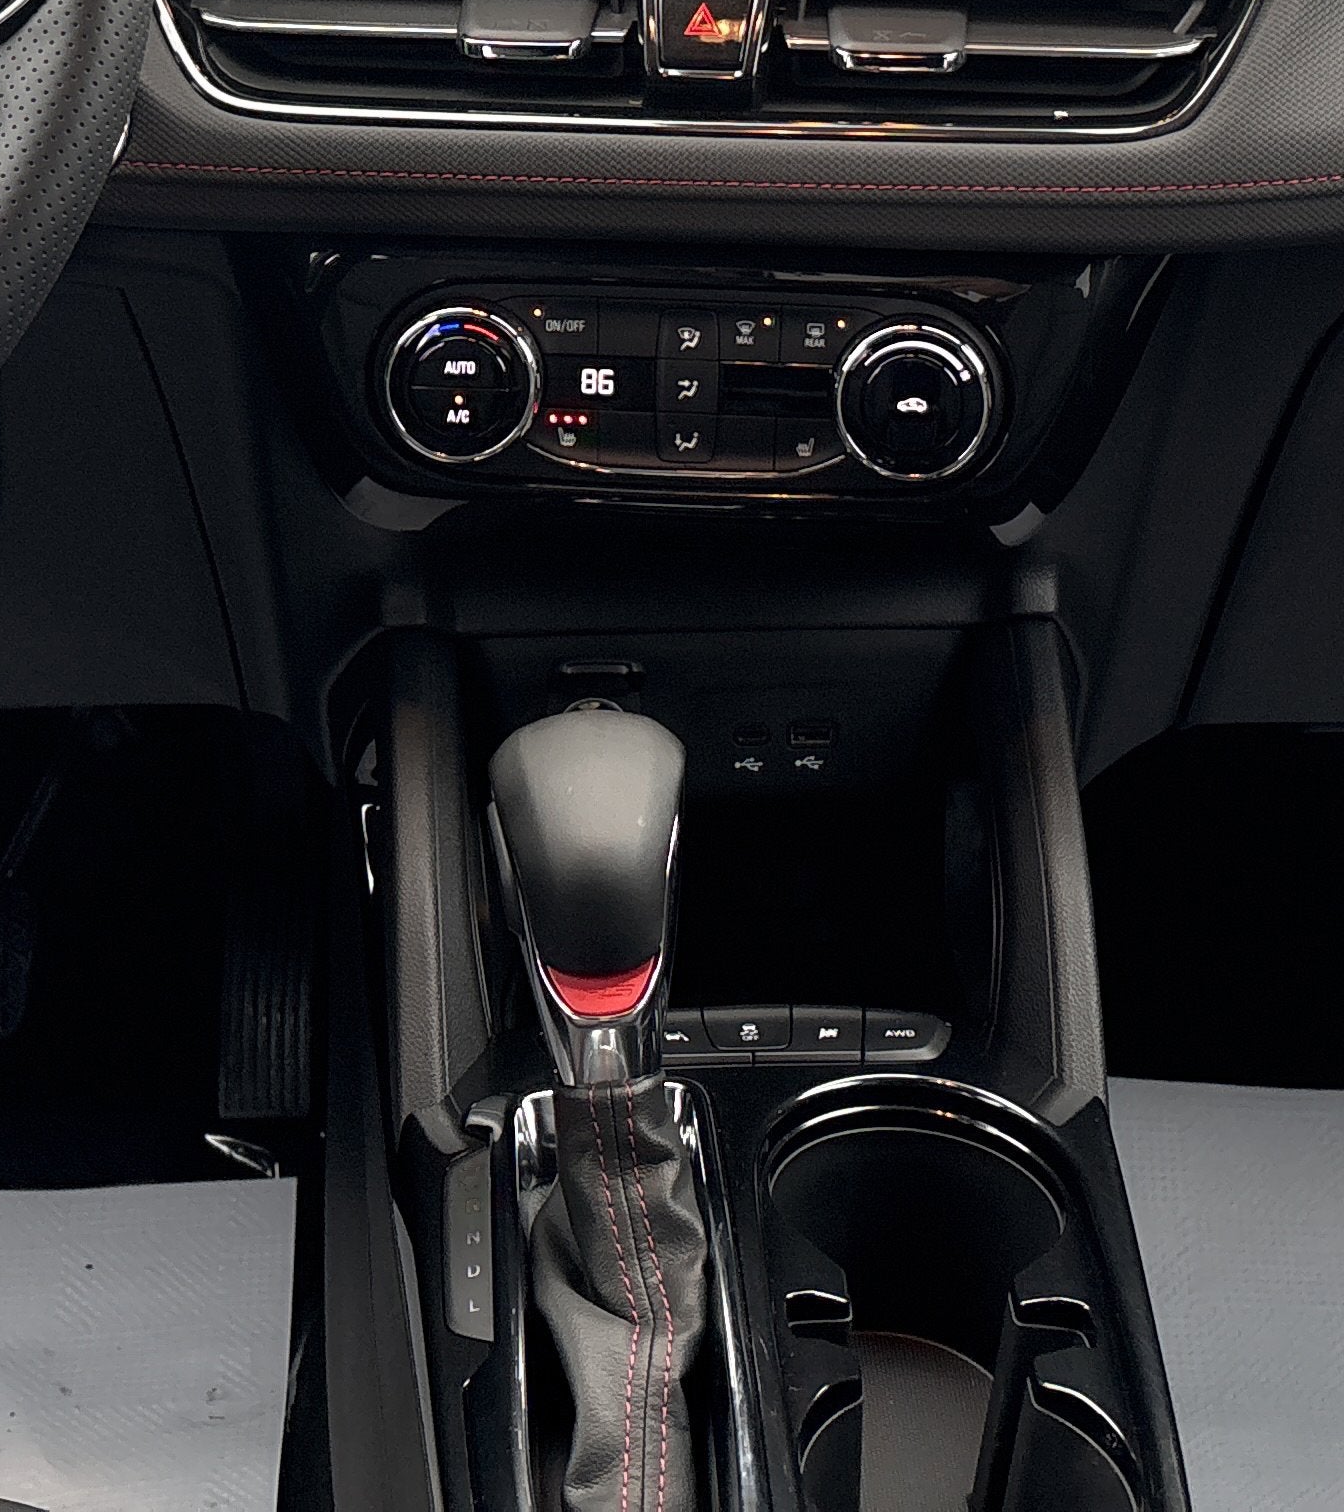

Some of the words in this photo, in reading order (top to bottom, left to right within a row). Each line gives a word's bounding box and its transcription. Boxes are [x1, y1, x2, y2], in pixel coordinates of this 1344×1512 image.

[545, 319, 586, 333] ON/OFF
[736, 335, 755, 345] MAX
[804, 337, 826, 348] REAR
[444, 360, 477, 375] AUTO
[580, 368, 615, 395] 86
[446, 409, 470, 424] A/C
[885, 1029, 916, 1038] AWD
[467, 1264, 481, 1278] D
[469, 1299, 480, 1313] L
